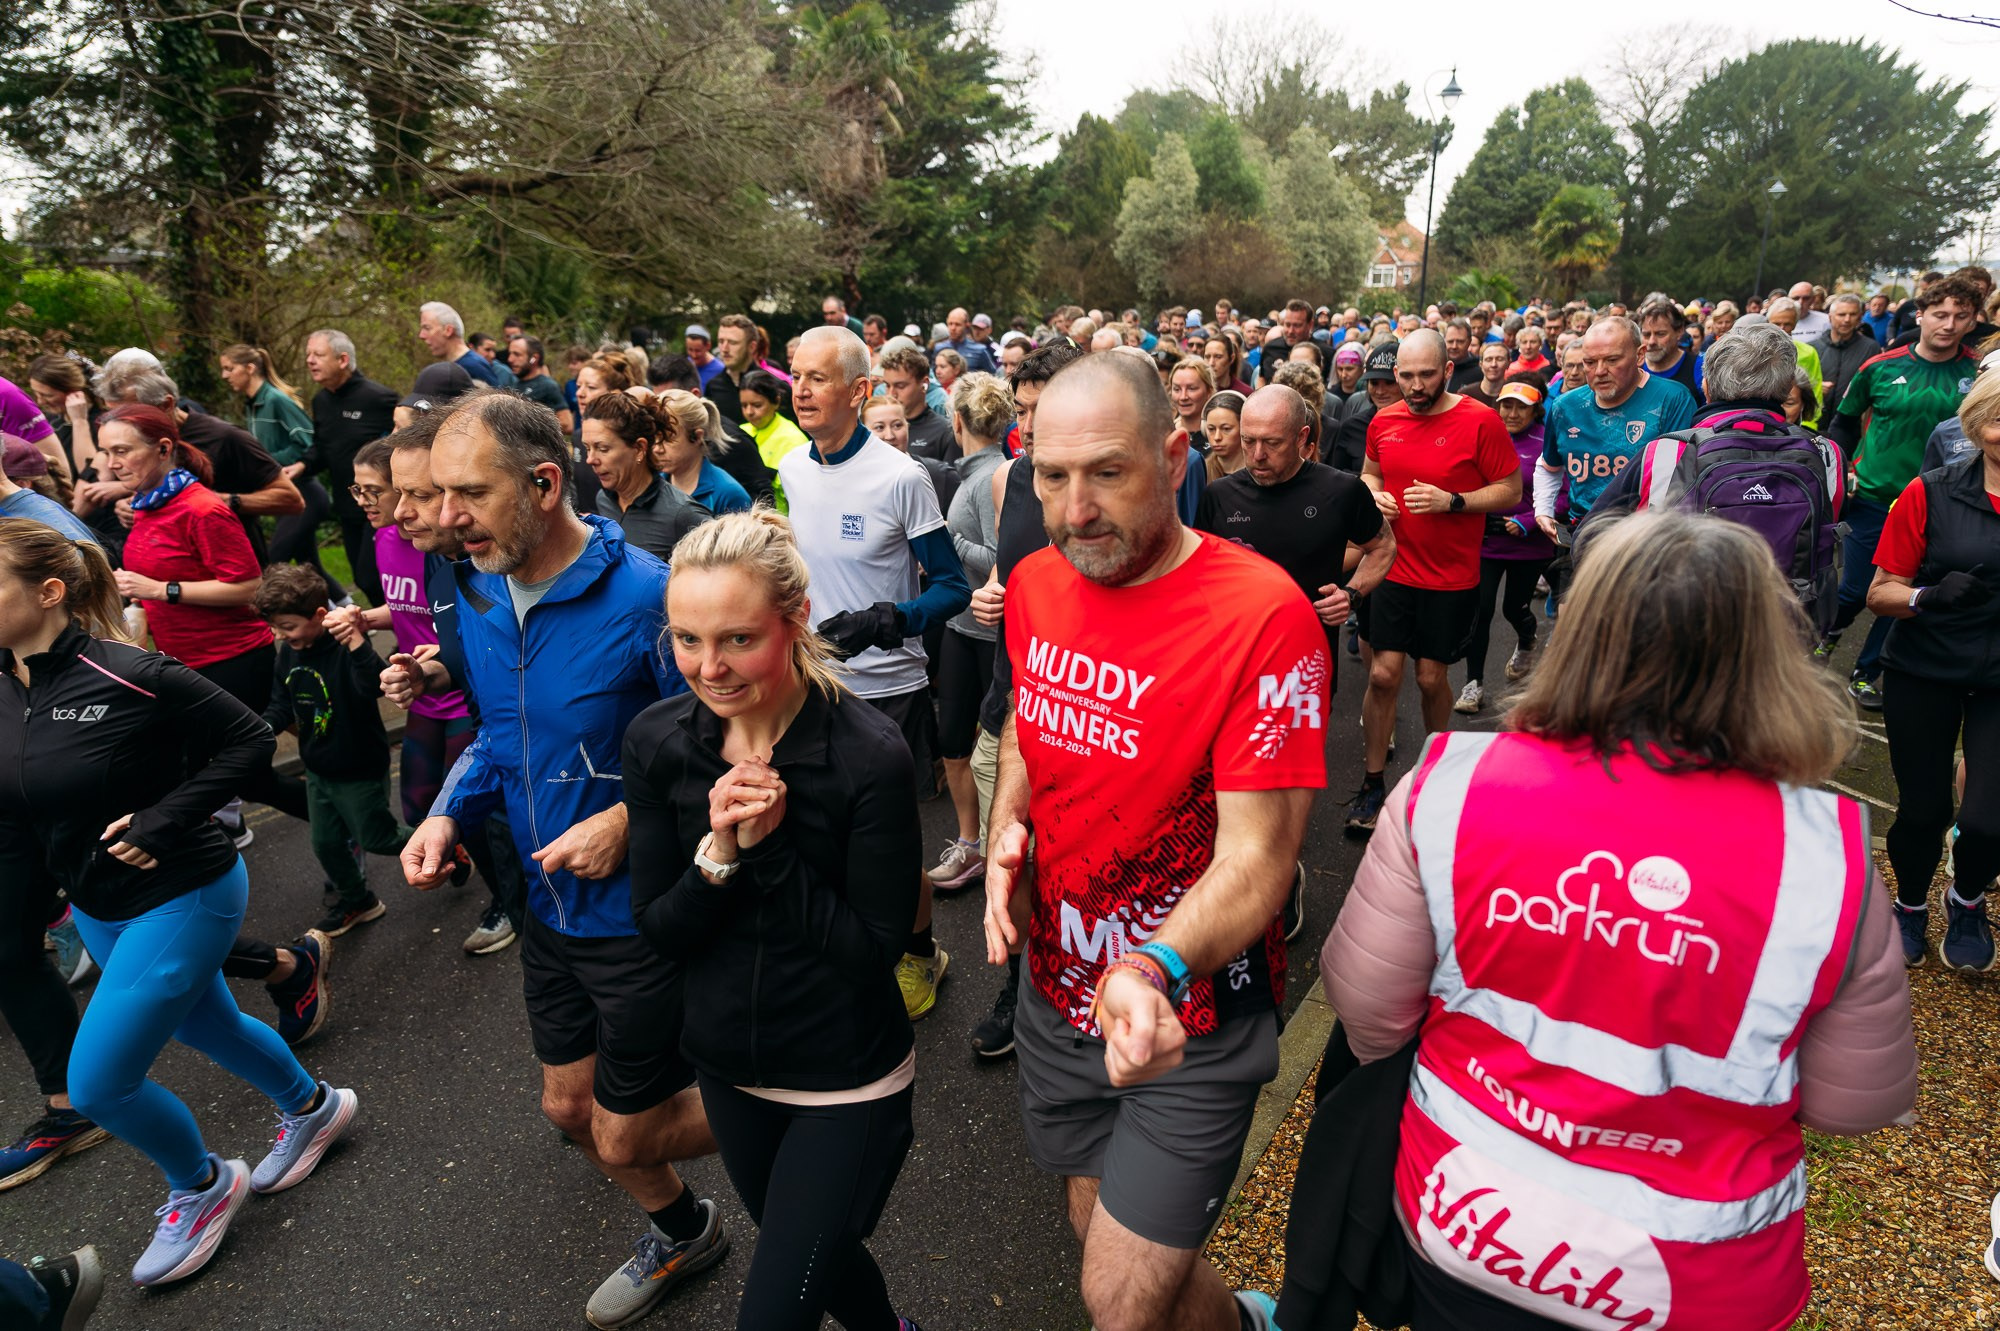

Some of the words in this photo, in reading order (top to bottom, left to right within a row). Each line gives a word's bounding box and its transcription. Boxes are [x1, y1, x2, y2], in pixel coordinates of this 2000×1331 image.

[1026, 636, 1156, 710] MUDDY
[1049, 687, 1112, 715] ANNIVERSARY
[52, 706, 77, 721] tcs
[1017, 685, 1140, 760] RUNNERS
[1038, 731, 1092, 757] 2014-2024
[1485, 850, 1720, 975] parkrun
[1466, 1057, 1684, 1158] VOLUNTEER
[1428, 1172, 1655, 1331] Vitality
